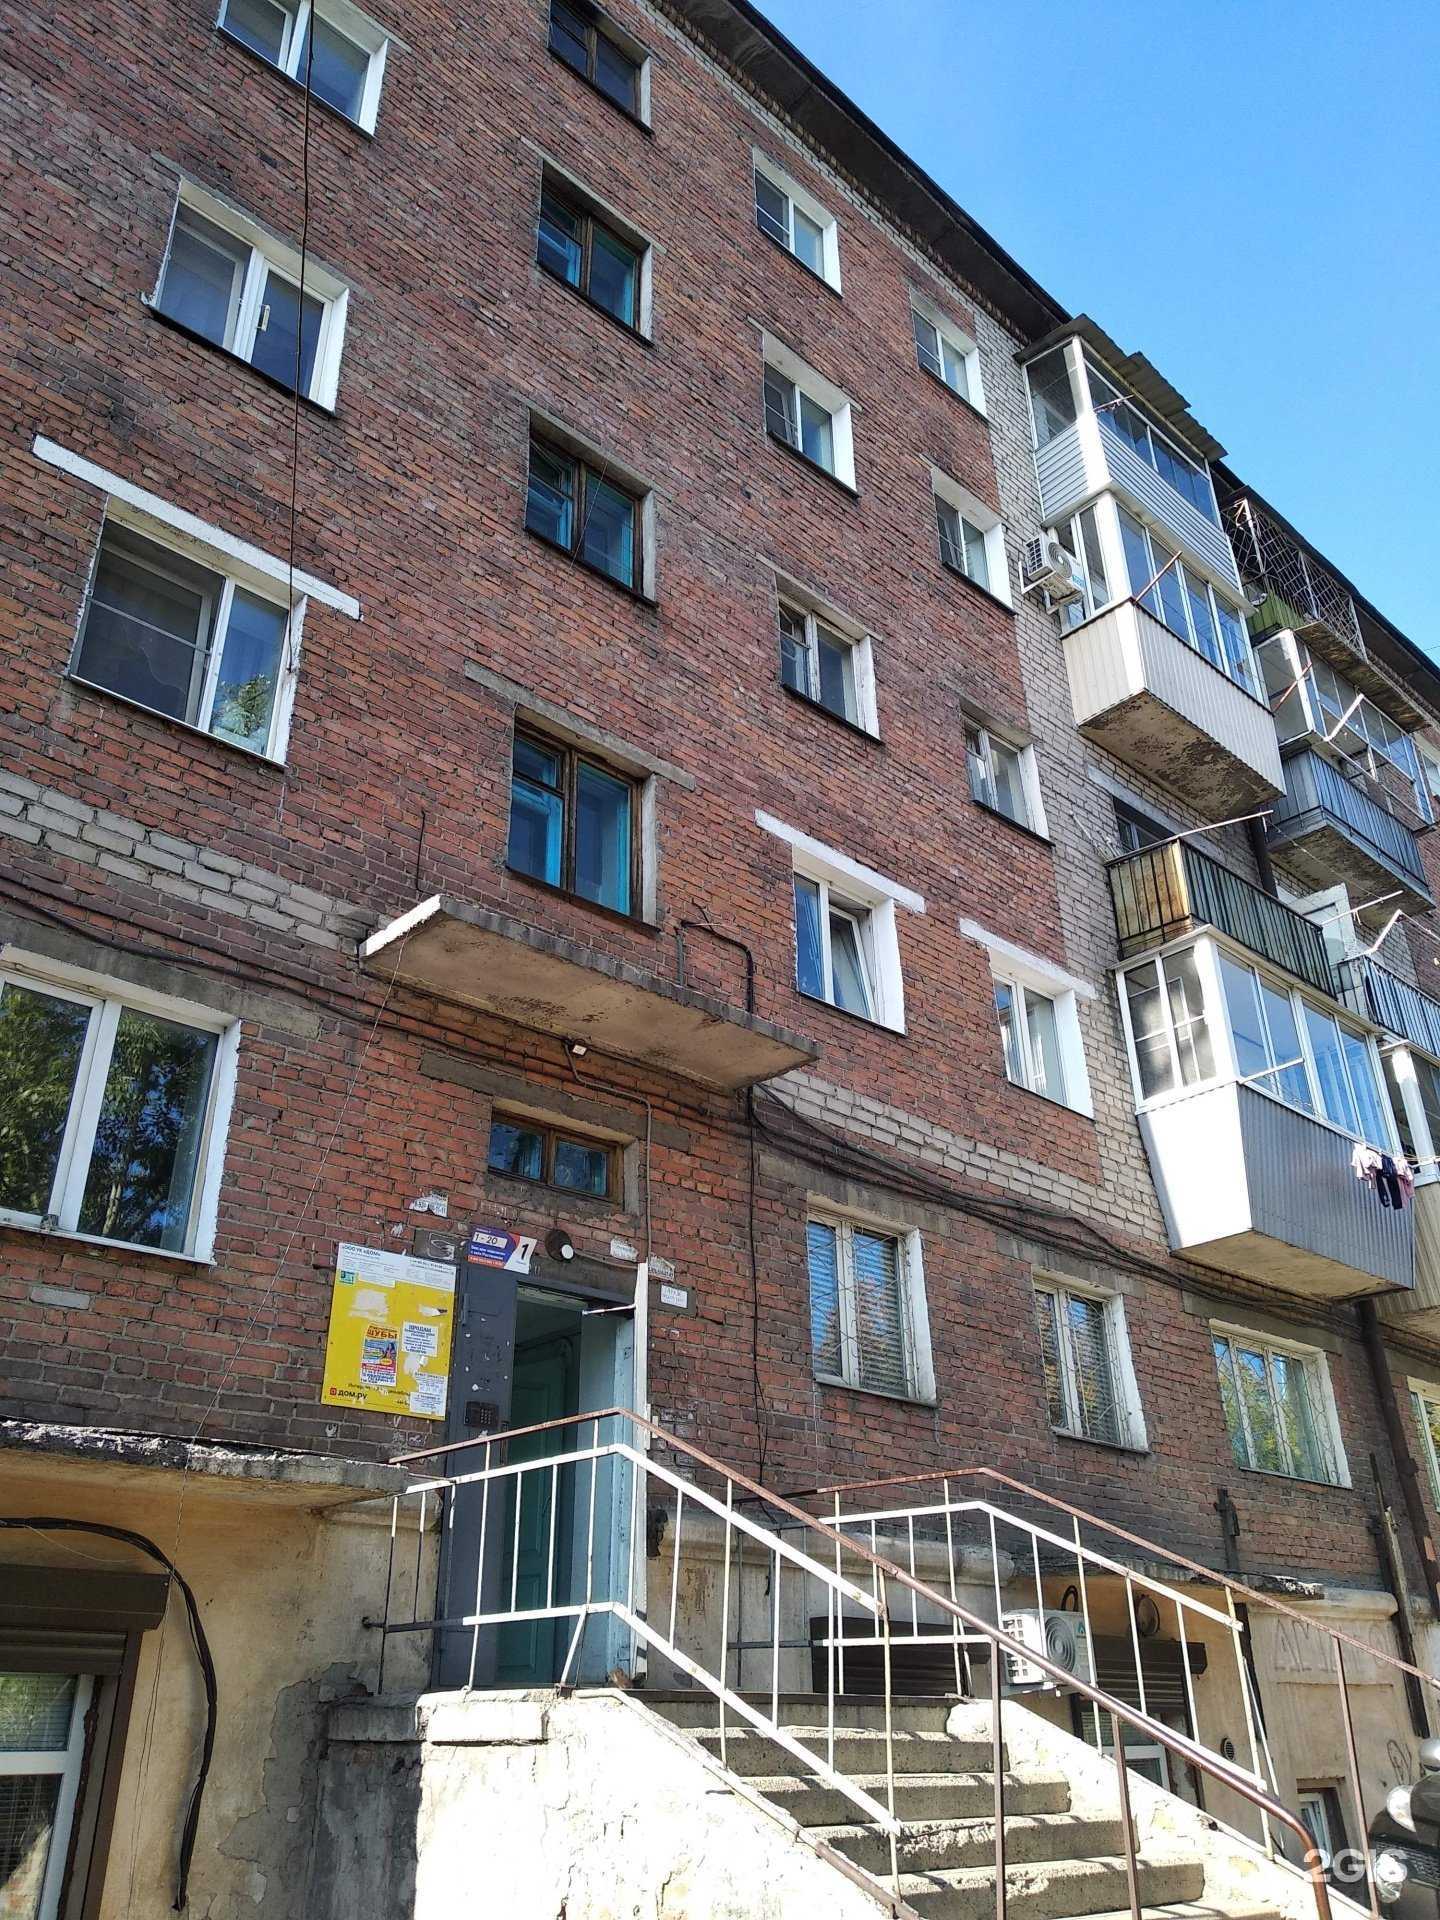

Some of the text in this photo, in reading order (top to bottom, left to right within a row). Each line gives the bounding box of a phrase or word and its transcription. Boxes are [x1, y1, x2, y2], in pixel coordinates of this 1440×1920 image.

[486, 1237, 498, 1245] 20
[521, 1243, 530, 1261] 1
[366, 1329, 398, 1339] ШУБЫ
